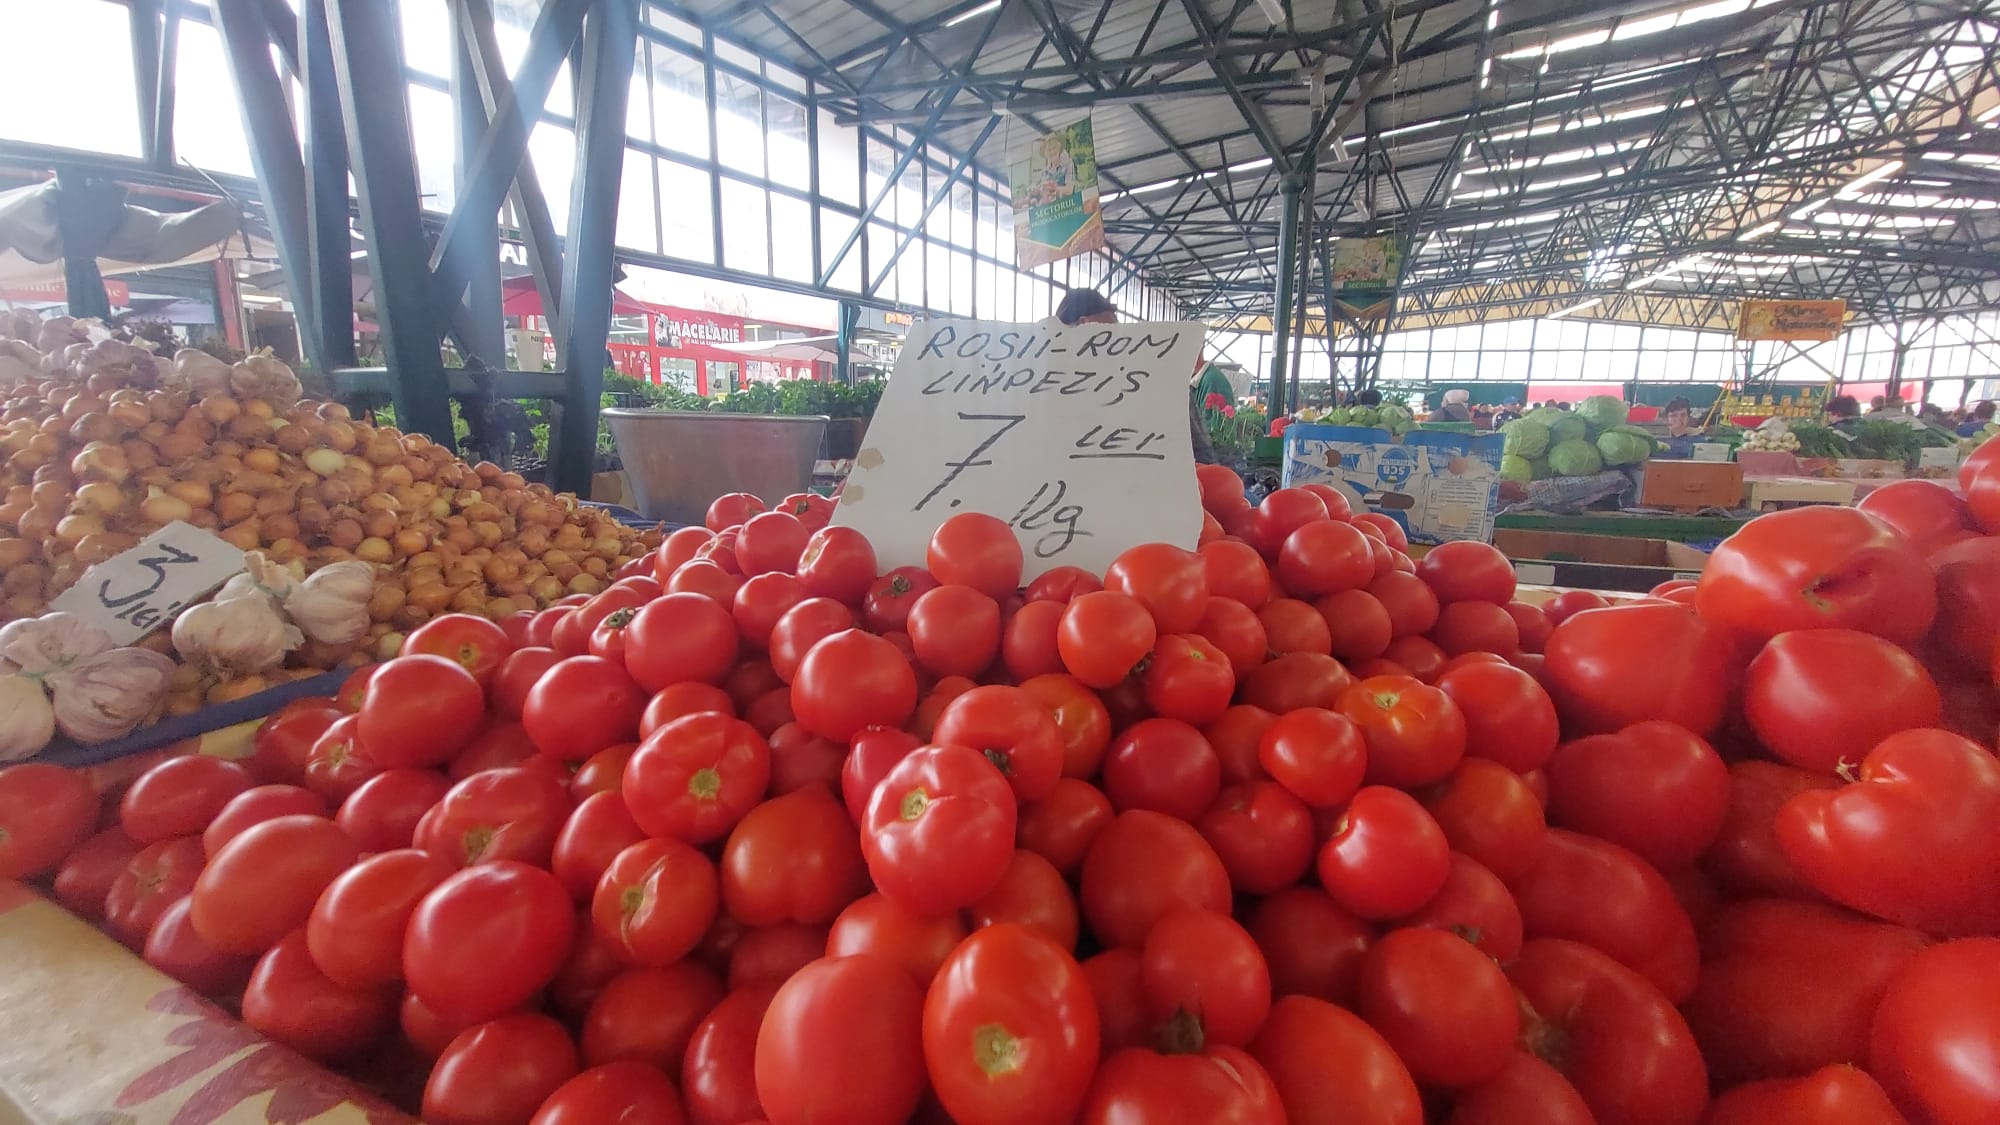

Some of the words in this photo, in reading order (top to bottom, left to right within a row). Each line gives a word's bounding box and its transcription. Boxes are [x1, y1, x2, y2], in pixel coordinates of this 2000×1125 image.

[1035, 198, 1076, 219] SECTORUL
[1382, 465, 1406, 476] SCB
[98, 543, 199, 608] 3
